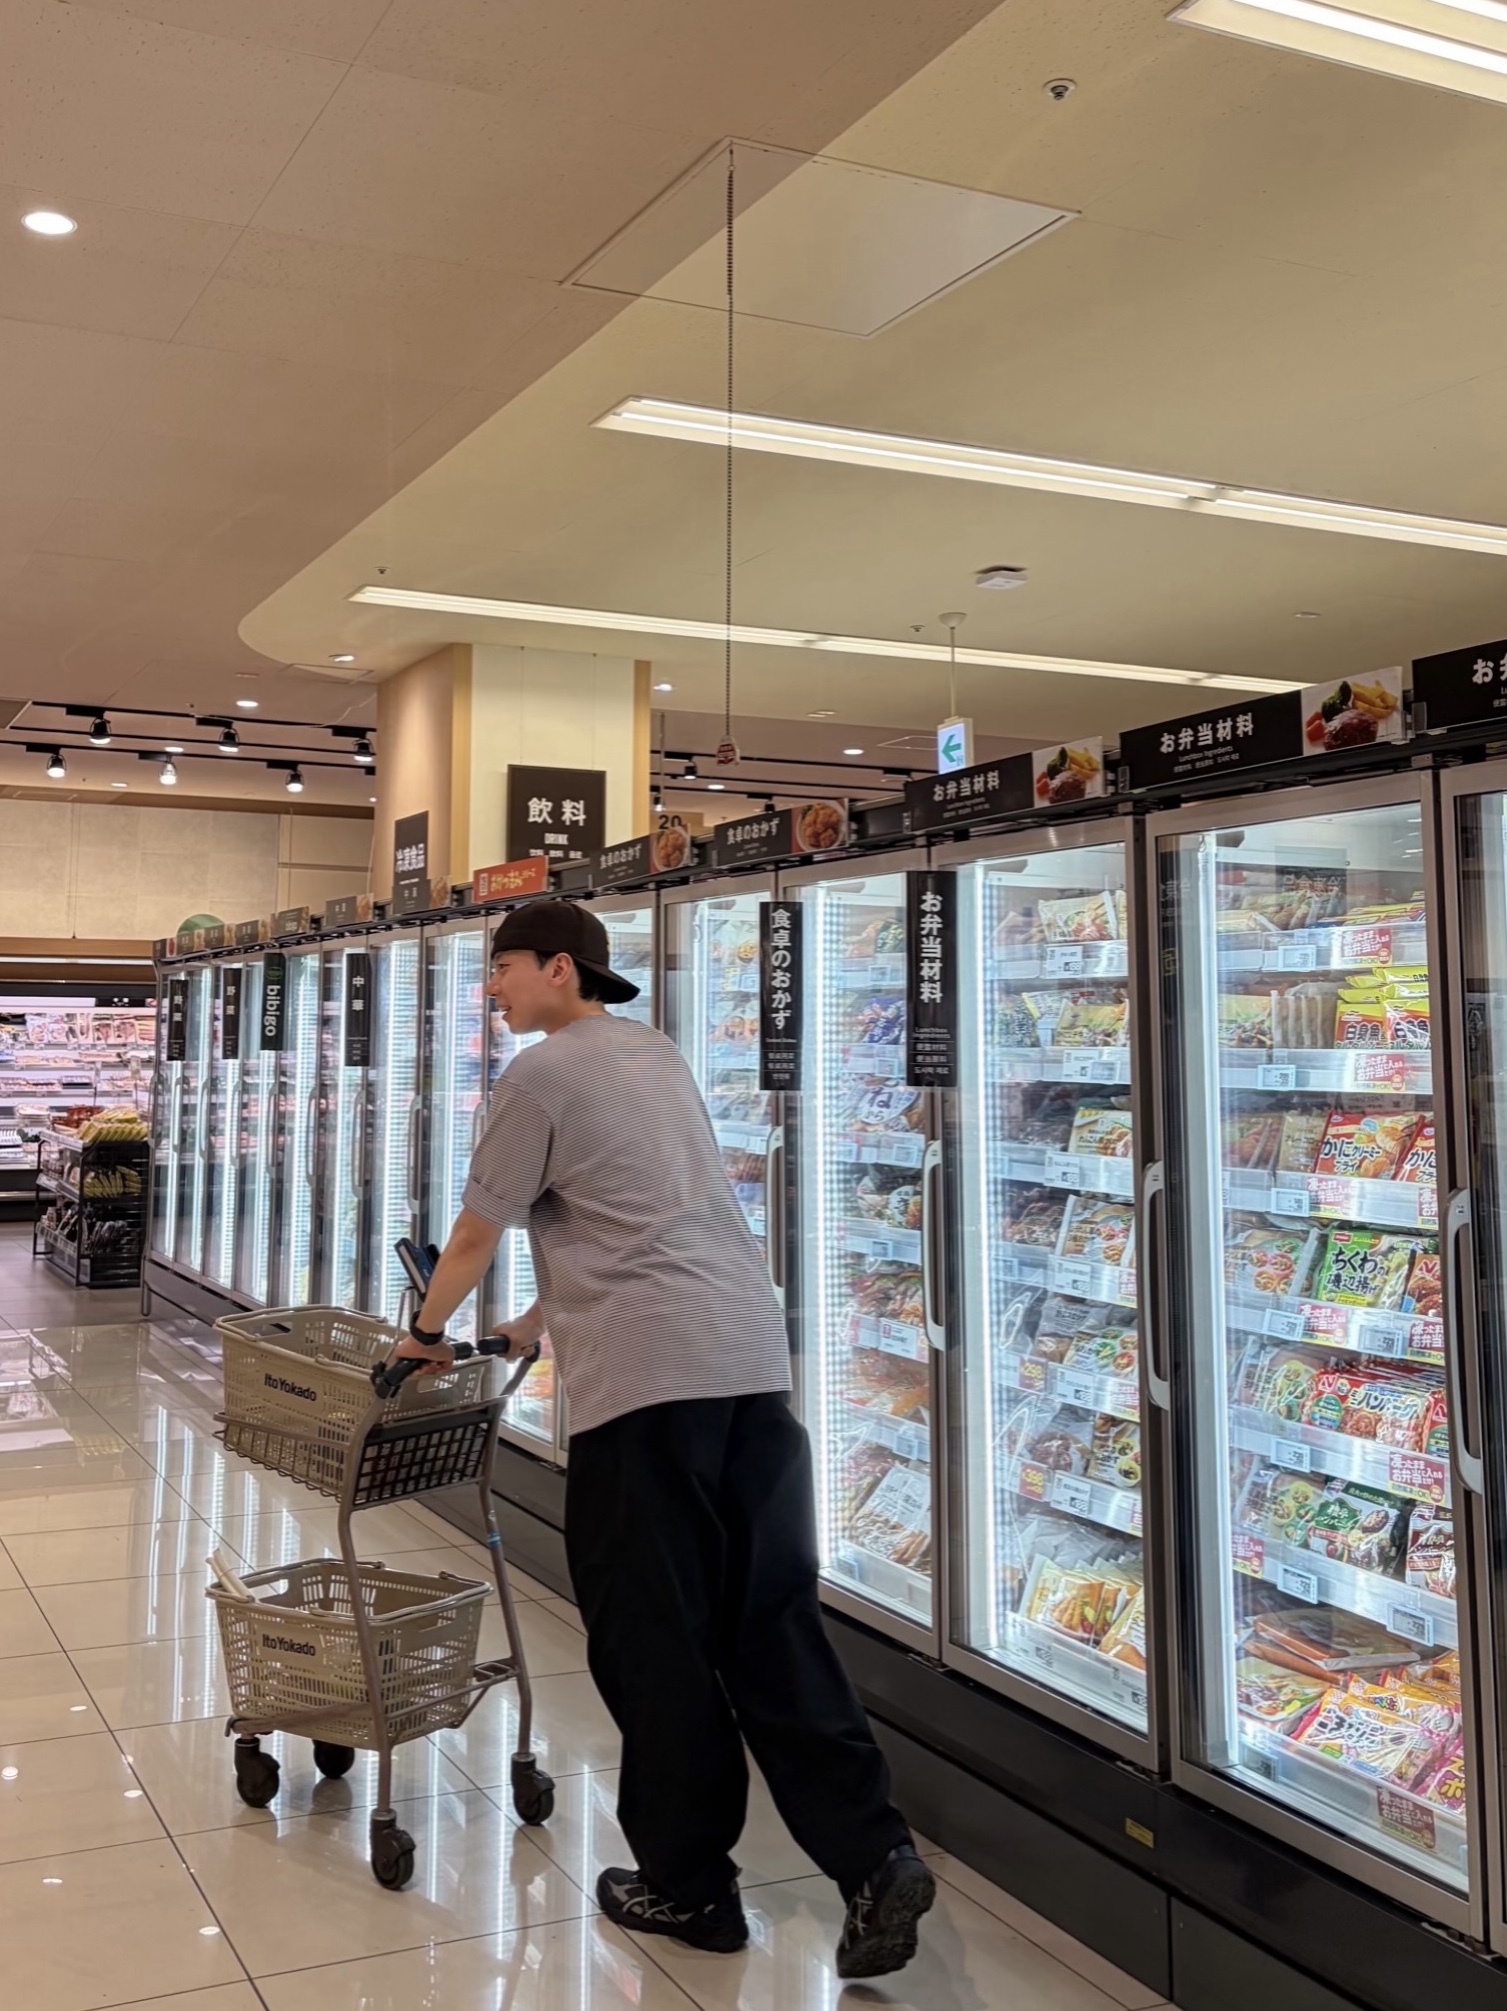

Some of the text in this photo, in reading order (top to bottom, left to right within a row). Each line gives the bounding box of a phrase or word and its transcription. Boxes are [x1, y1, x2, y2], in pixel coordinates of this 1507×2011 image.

[1160, 712, 1254, 754] お弁当材料
[933, 769, 1000, 801] お弁当材料
[528, 797, 587, 826] 飲料
[658, 814, 683, 830] 20
[544, 833, 569, 845] DRINK
[726, 817, 781, 845] 食卓のおかず
[600, 843, 642, 869] 食卓のおかず
[920, 891, 943, 1004] お弁当材料
[770, 908, 792, 1030] 食卓のおかず
[263, 984, 282, 1037] bibigo
[1321, 1137, 1381, 1159] かにクリーミー
[1334, 1160, 1359, 1174] フライ
[1332, 1246, 1388, 1276] ちくわの
[1327, 1274, 1378, 1296] 磯辺揚げ
